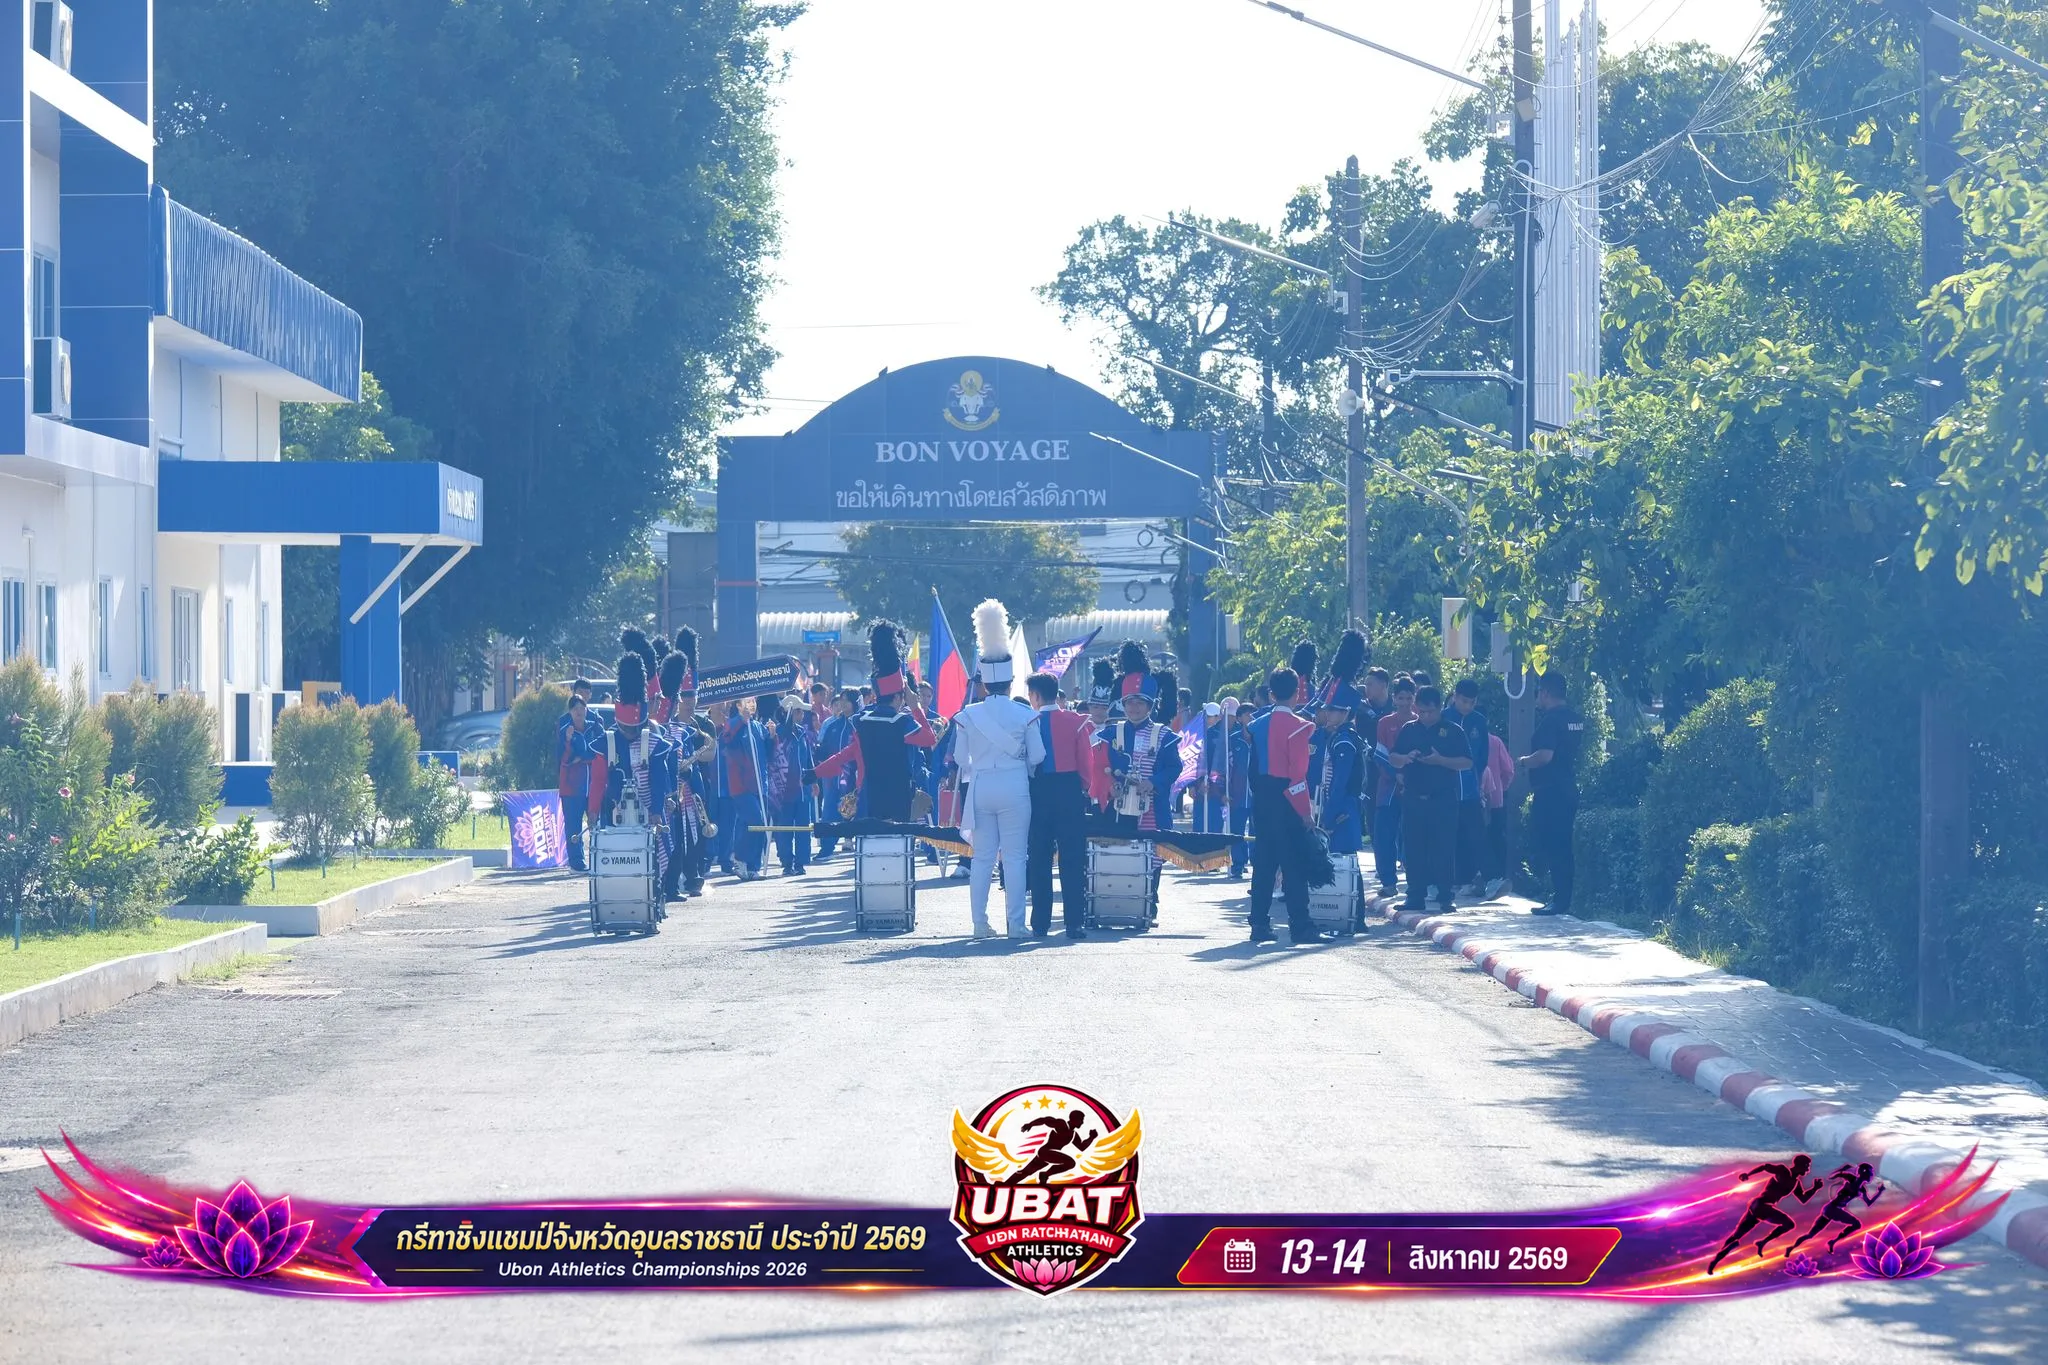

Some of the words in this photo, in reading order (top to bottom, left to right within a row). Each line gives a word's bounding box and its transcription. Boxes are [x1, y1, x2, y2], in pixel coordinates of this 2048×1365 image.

[875, 441, 940, 463] BON
[948, 440, 1070, 462] VOYAGE
[836, 479, 1107, 508] ขอให้เดินทางโดยสวัสดิภาพ
[611, 856, 641, 865] YAMAHA
